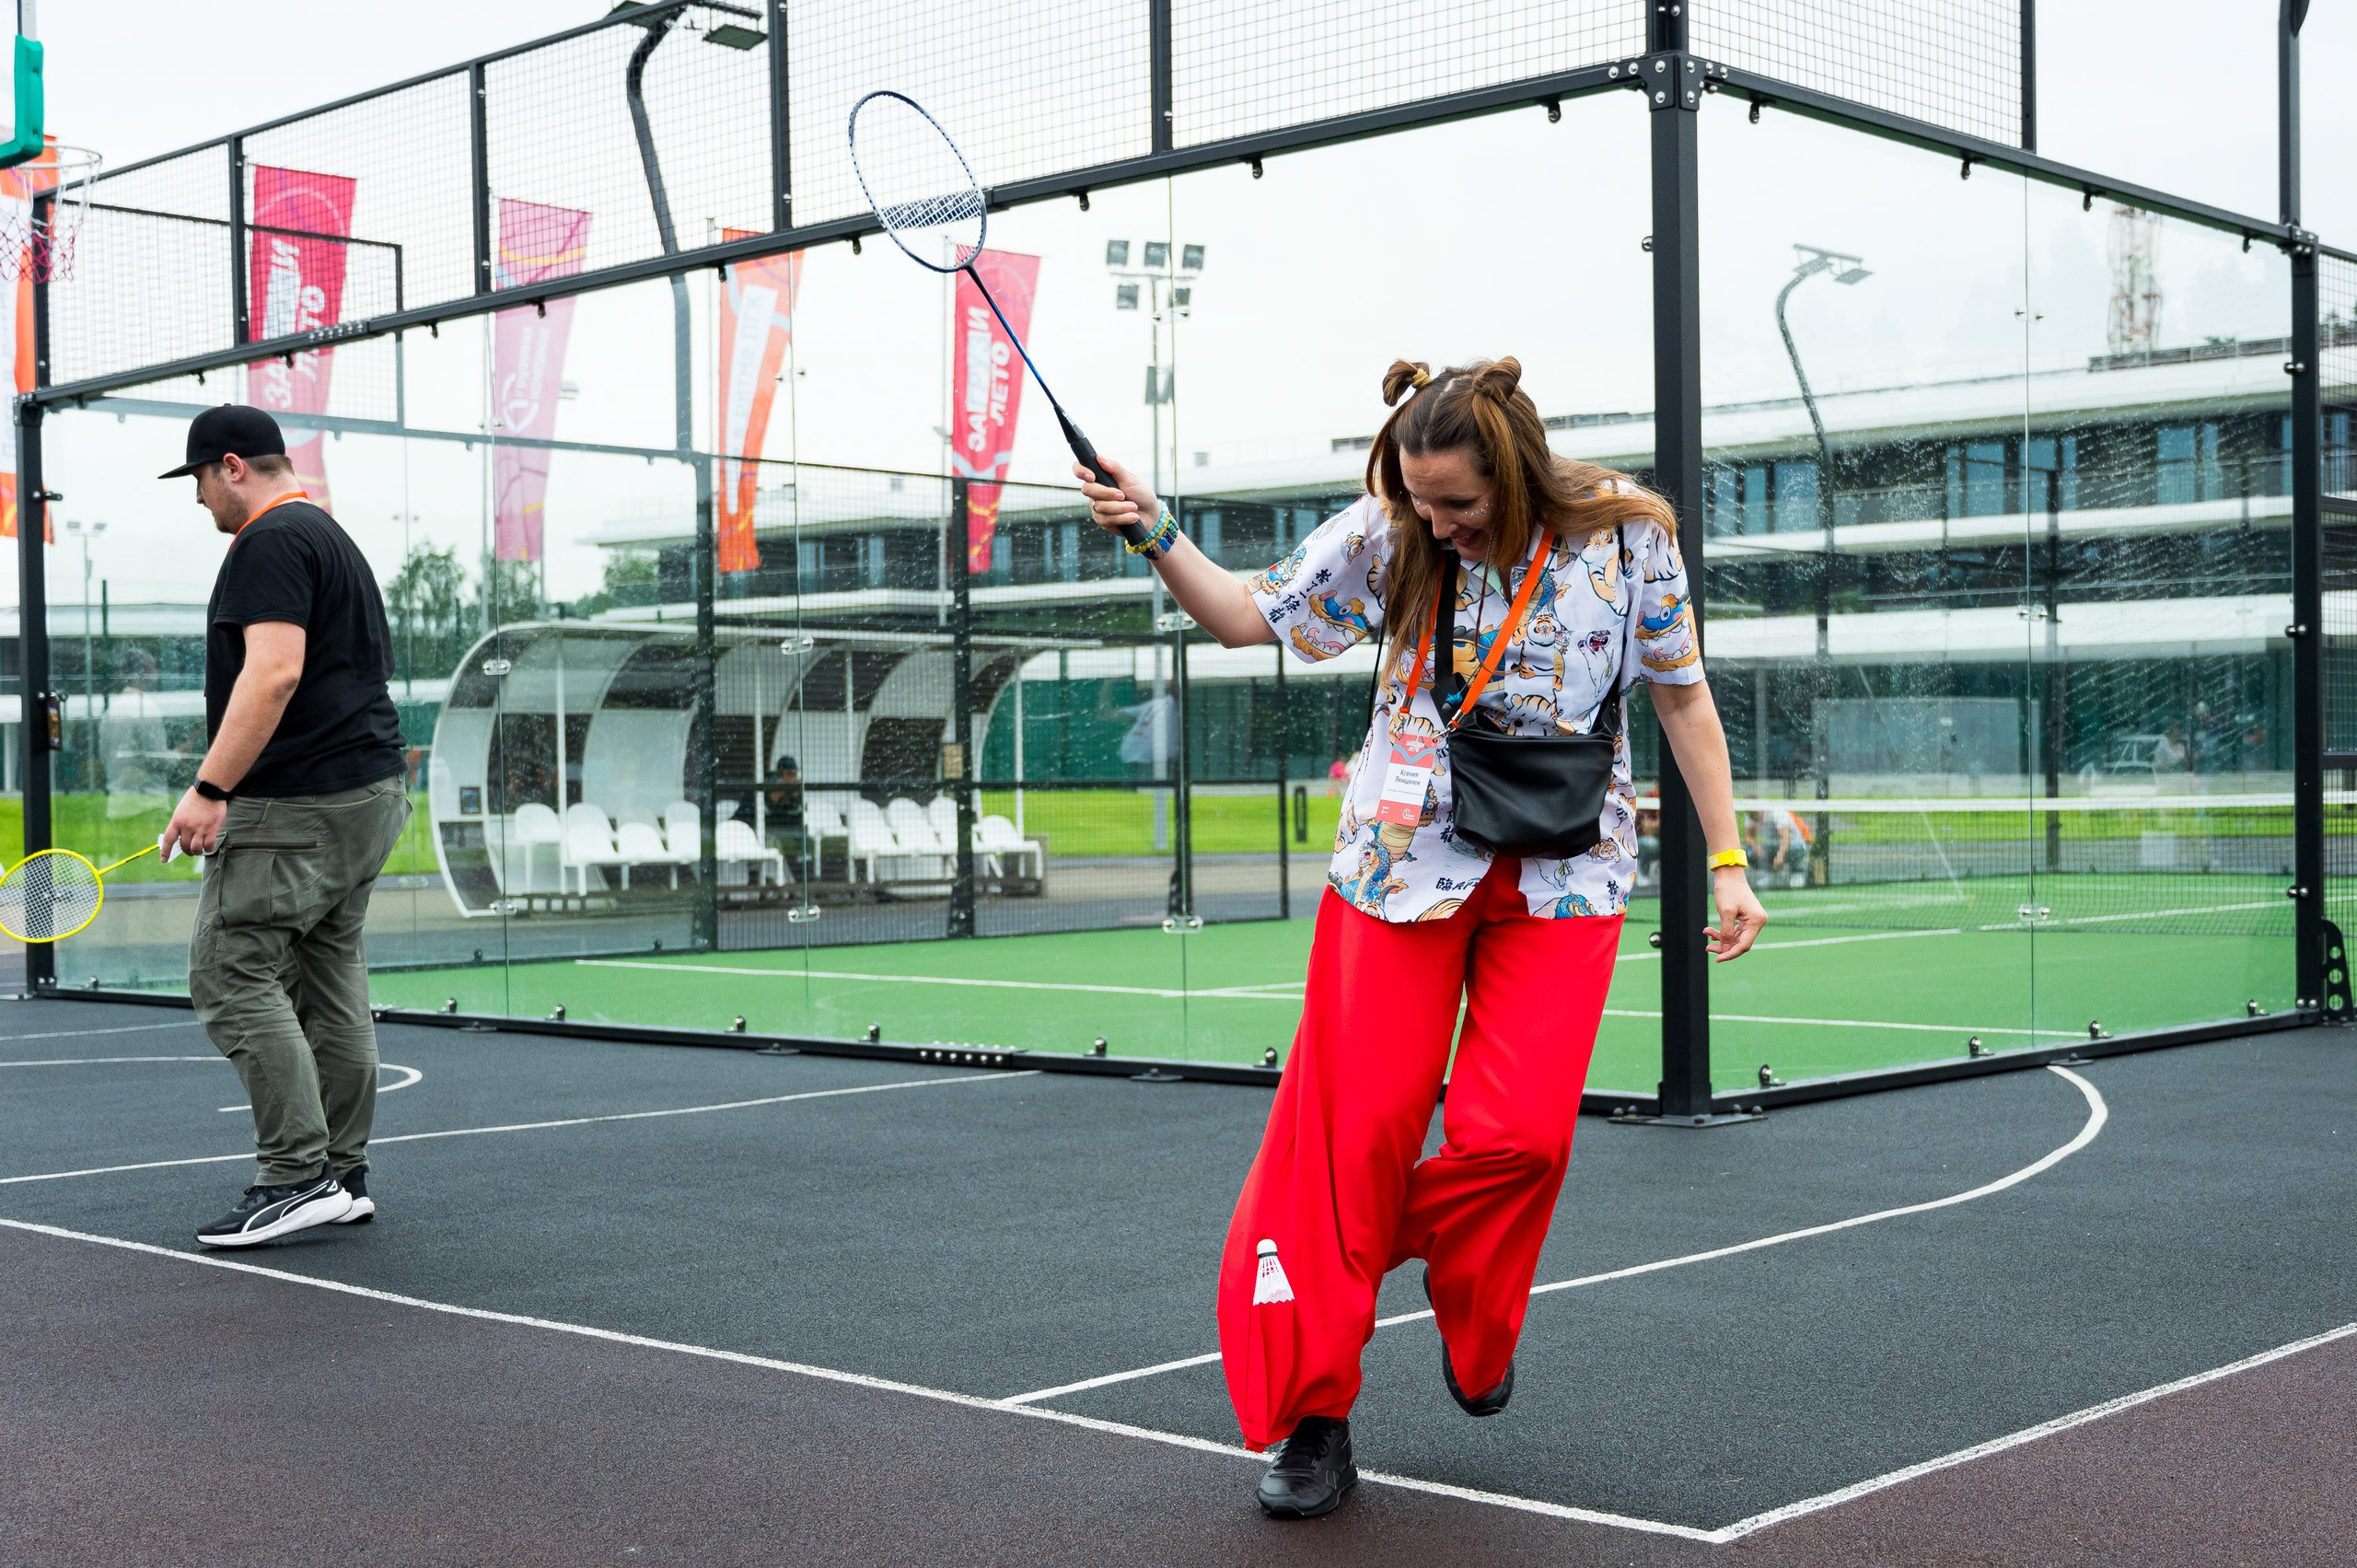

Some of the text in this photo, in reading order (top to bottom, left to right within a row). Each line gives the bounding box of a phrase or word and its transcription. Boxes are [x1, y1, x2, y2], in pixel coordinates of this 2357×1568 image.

[296, 285, 325, 381] ЛТО
[990, 341, 1010, 427] ЛЕТО
[1400, 769, 1419, 777] Ксения
